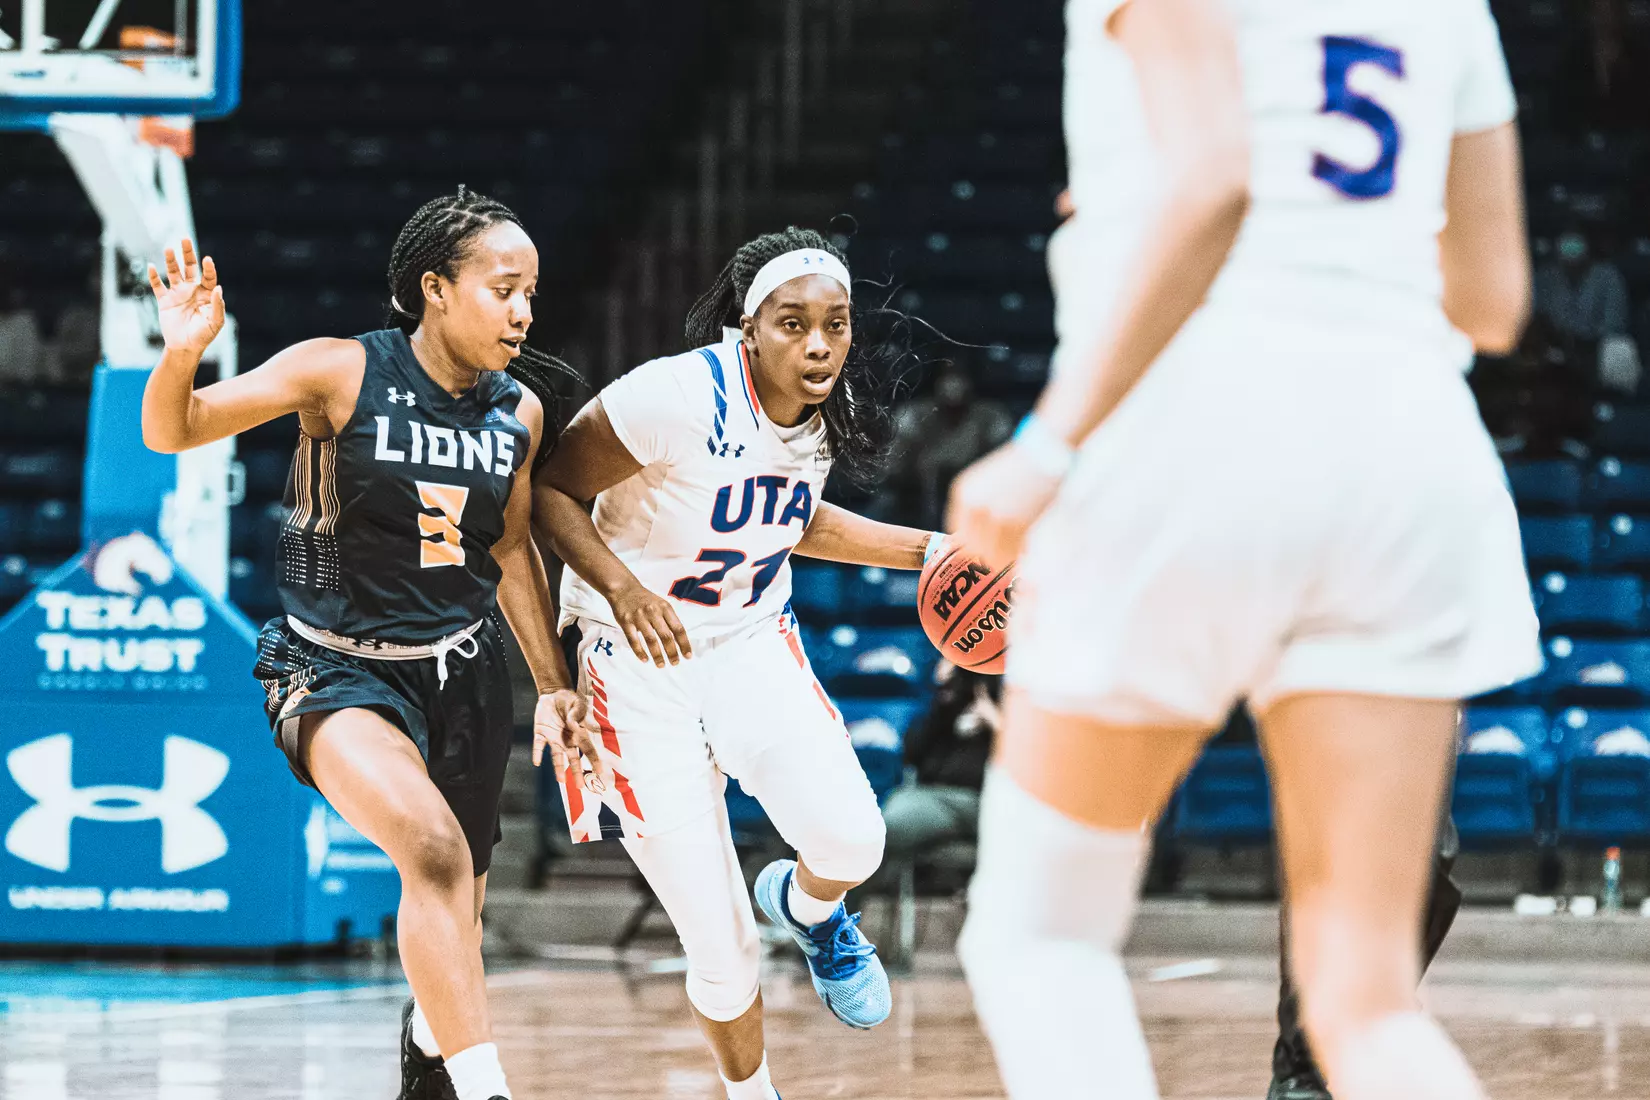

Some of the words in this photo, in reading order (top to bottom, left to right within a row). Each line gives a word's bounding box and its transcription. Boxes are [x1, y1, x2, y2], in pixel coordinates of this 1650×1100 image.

[1309, 34, 1405, 201] 5
[374, 415, 515, 477] LIONS
[415, 481, 469, 568] 3
[710, 475, 812, 533] UTA
[667, 546, 795, 608] 21
[933, 561, 991, 621] NCAA
[36, 591, 207, 631] TEXAS
[954, 583, 1011, 653] ilson
[36, 632, 205, 673] TRUST
